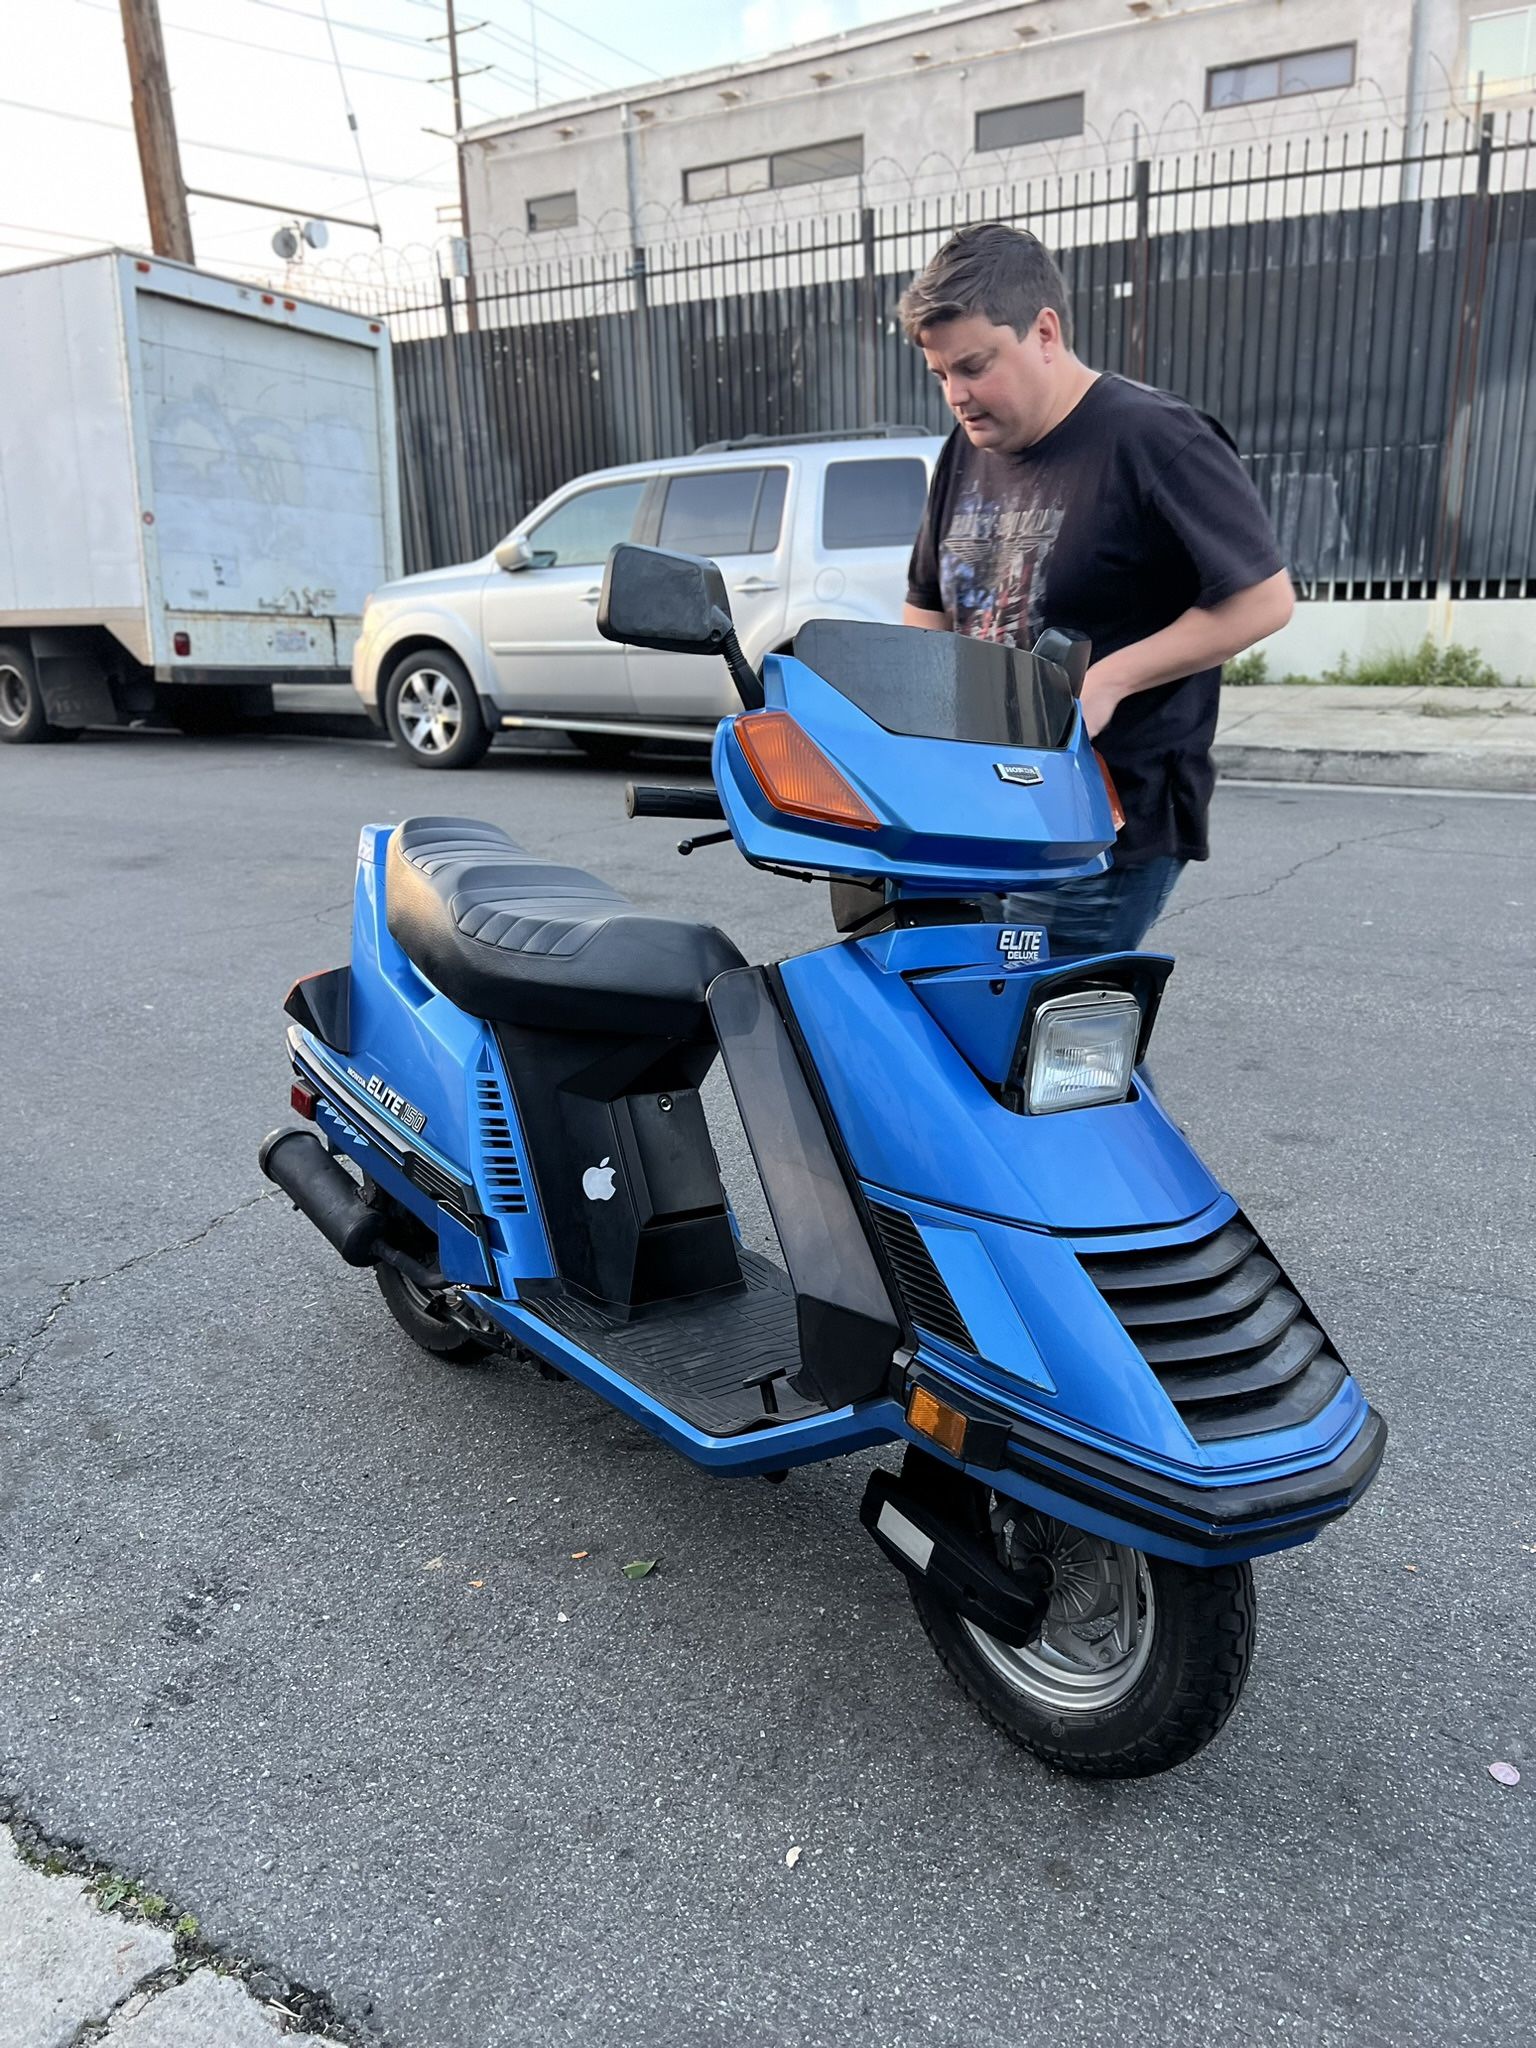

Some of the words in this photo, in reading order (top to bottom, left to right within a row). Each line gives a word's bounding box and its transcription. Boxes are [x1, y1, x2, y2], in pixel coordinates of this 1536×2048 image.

[1005, 766, 1036, 775] HONDA
[999, 930, 1043, 951] ELITE
[1007, 951, 1039, 960] DELUXE
[346, 1066, 367, 1088] HONDA
[366, 1074, 405, 1117] ELITE
[400, 1103, 426, 1133] 150
